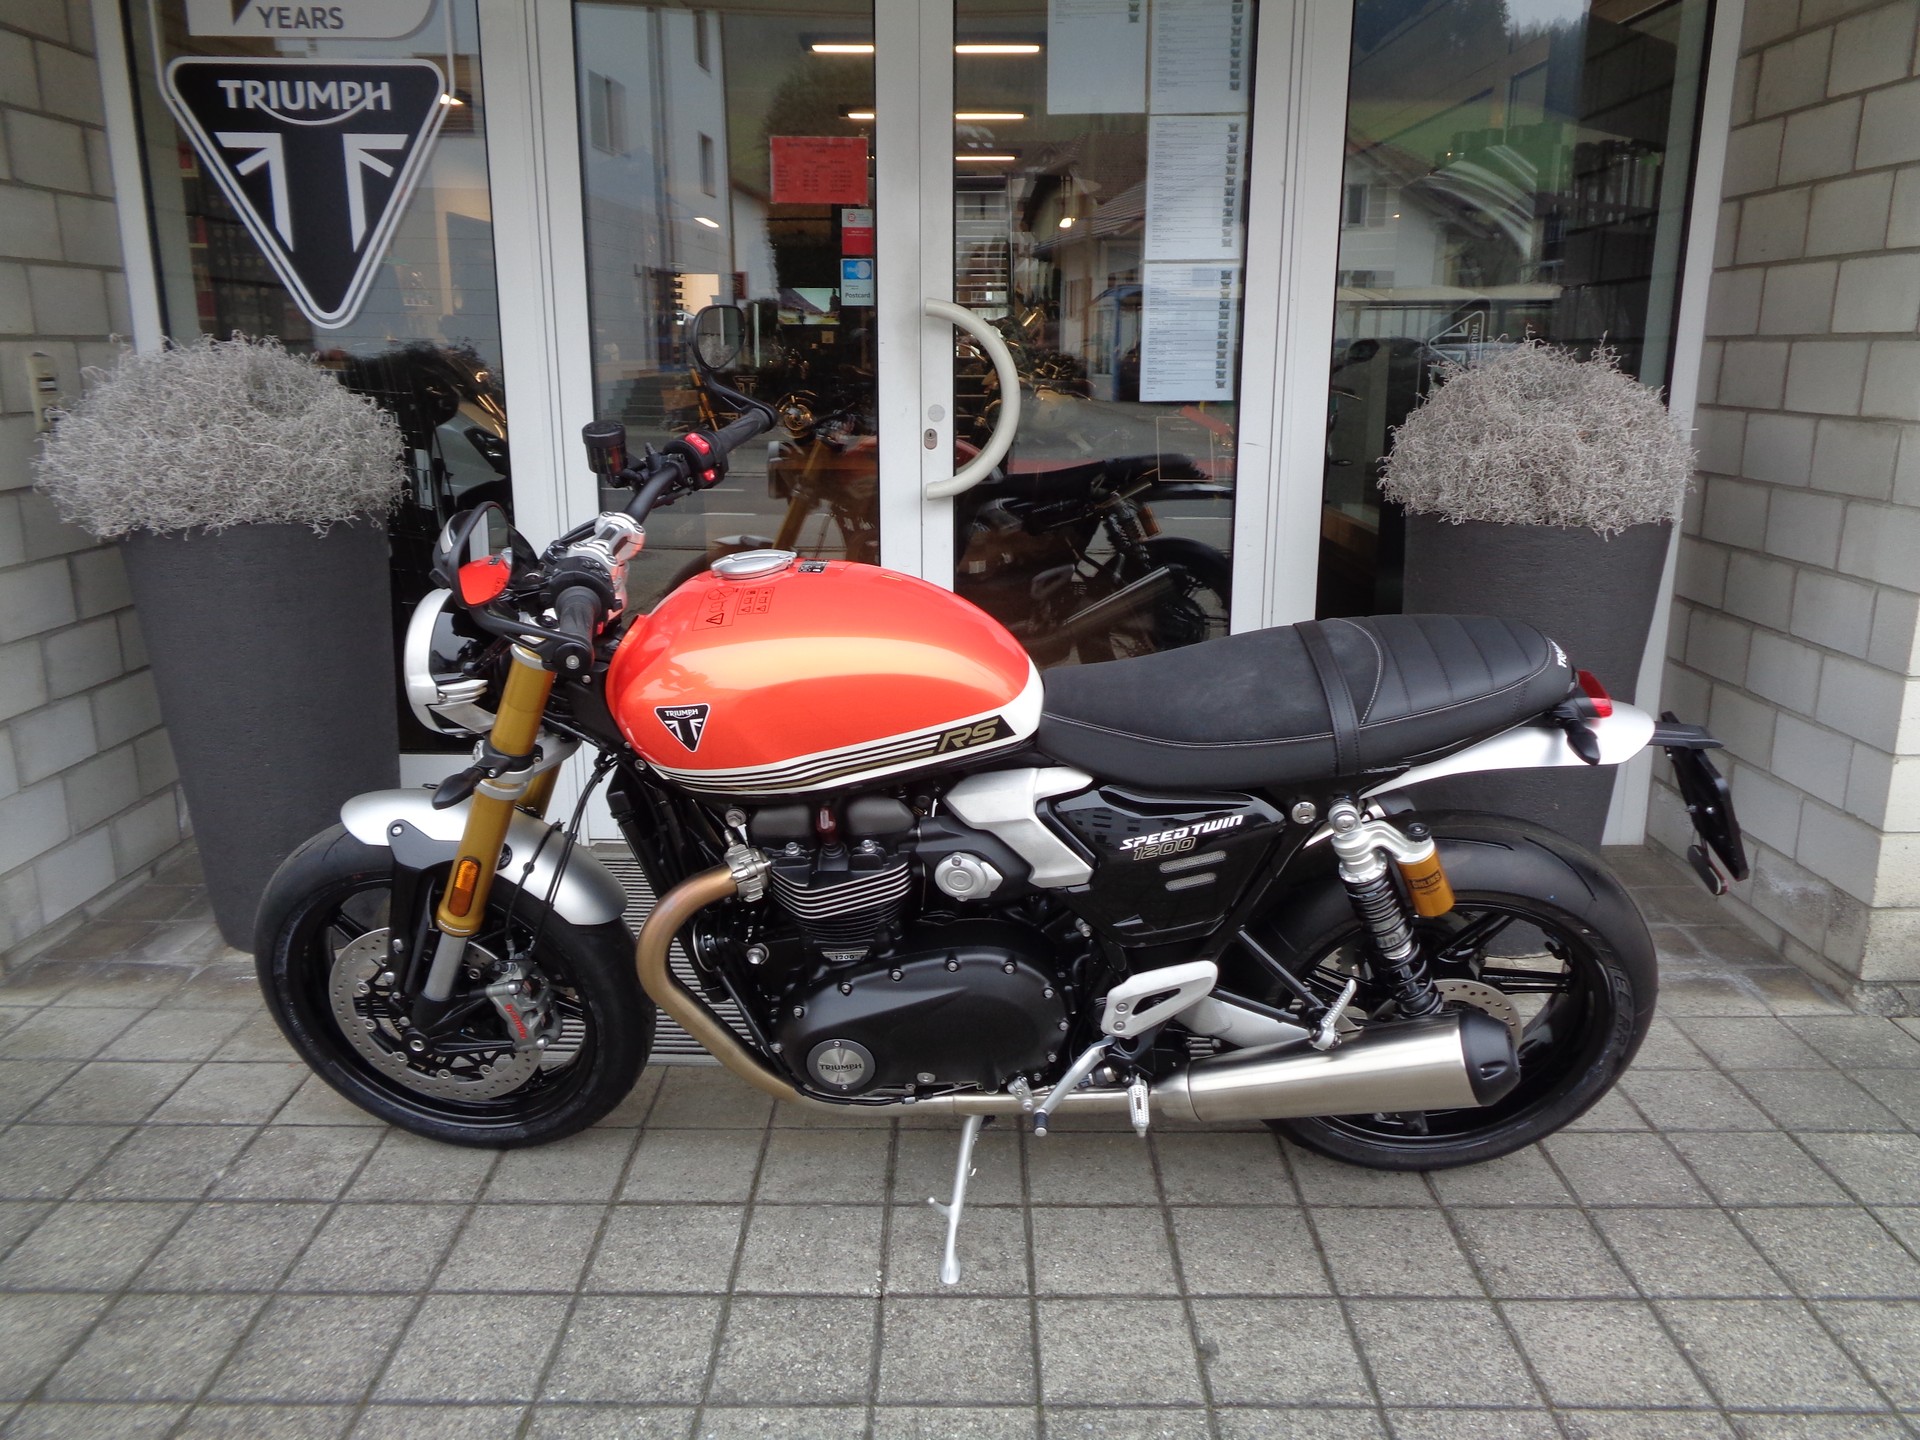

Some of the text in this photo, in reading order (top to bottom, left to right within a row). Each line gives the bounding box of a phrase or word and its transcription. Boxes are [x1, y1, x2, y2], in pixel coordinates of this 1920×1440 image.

[256, 6, 344, 30] YEARS
[217, 79, 391, 125] TRIUMPH
[664, 709, 698, 719] TRIUMPH
[938, 718, 1000, 752] RS
[1120, 815, 1244, 850] SPEED TWIN
[1133, 836, 1197, 860] 1200
[819, 1063, 862, 1072] TRIUMPH
